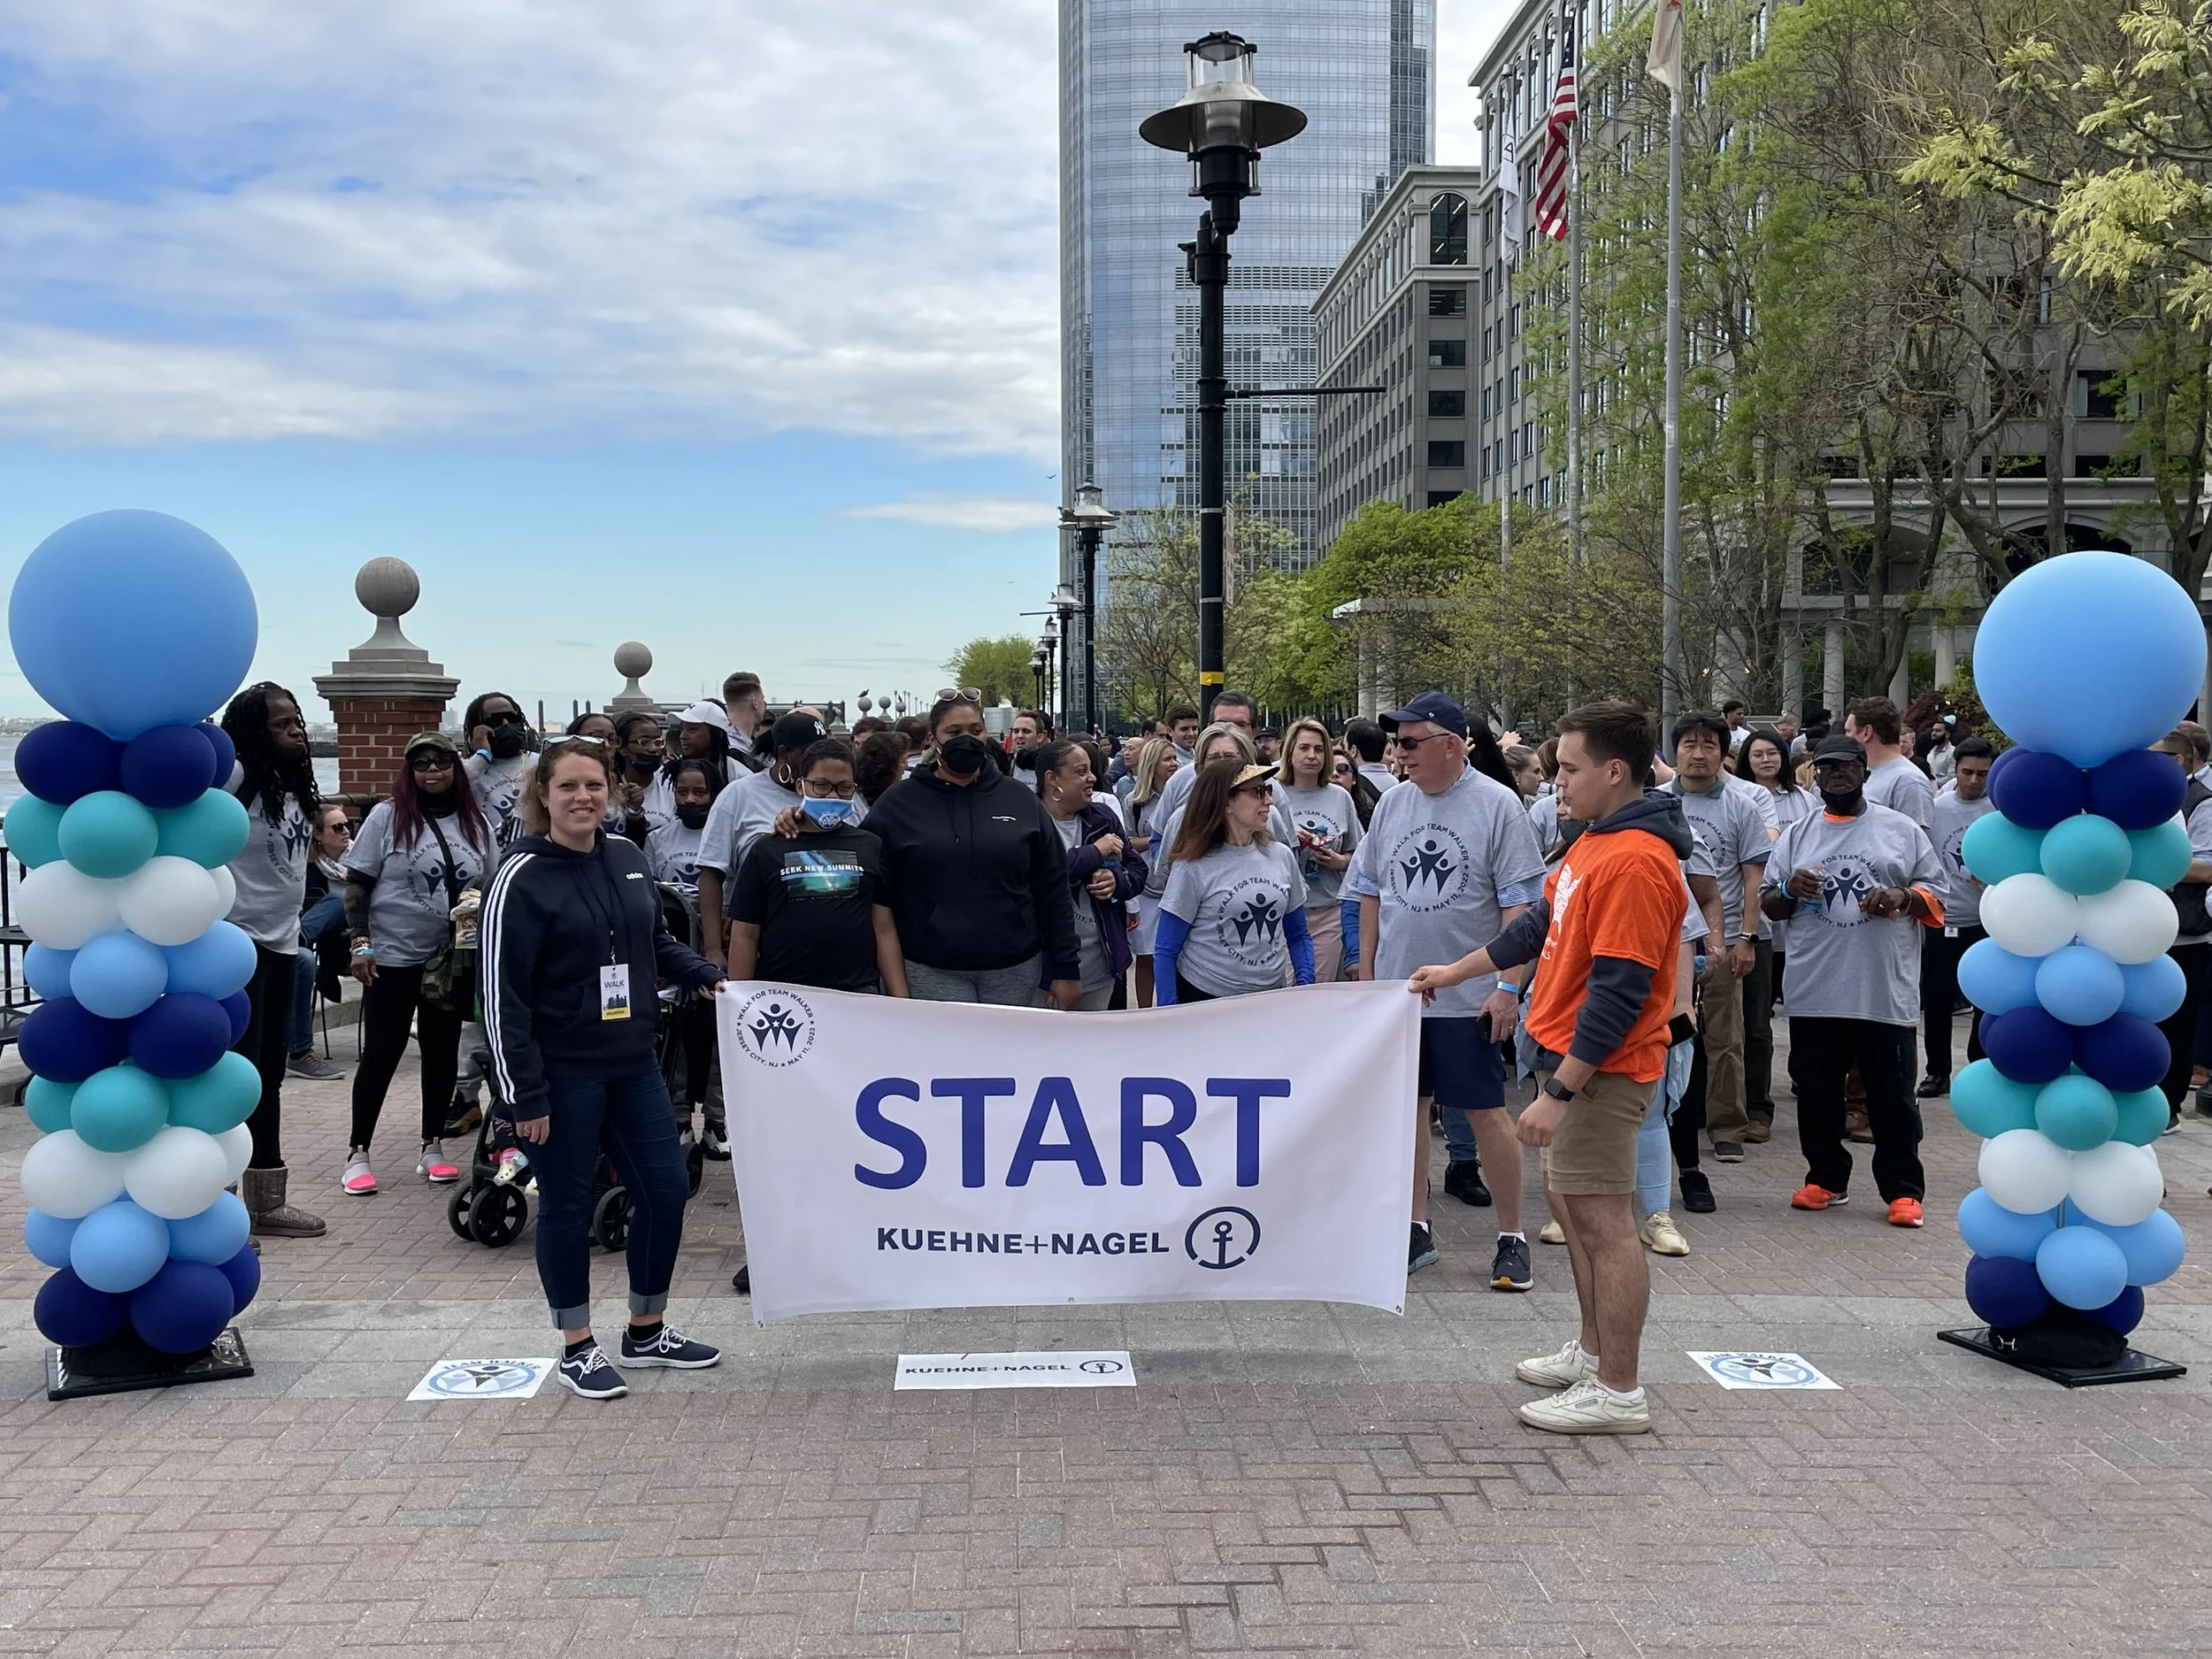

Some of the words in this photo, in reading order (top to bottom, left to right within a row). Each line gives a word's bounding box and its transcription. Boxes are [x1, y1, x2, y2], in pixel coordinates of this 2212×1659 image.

[1322, 813, 1340, 833] WALKER
[1687, 815, 1706, 824] TEAM
[1706, 820, 1725, 845] WALKER
[1392, 835, 1409, 856] WALK
[1410, 826, 1425, 837] FOR
[1426, 823, 1448, 833] TEAM
[1448, 829, 1469, 861] WALKER
[410, 848, 427, 867] WALK
[780, 866, 803, 876] SEEK
[1822, 856, 1837, 865] FOR
[1860, 856, 1881, 883] WALKER
[1217, 890, 1235, 914] WALK
[1233, 879, 1248, 892] FOR
[1432, 899, 1450, 911] MAY
[1458, 872, 1469, 893] 2022
[1858, 916, 1873, 926] MAY
[1217, 922, 1230, 948] JERSEY
[1228, 947, 1245, 964] CITY,
[604, 979, 625, 988] WALK
[737, 1001, 752, 1020] WALK
[750, 990, 766, 1002] FOR
[790, 993, 813, 1018] WALKER
[736, 1028, 751, 1053] JERSEY
[787, 1053, 803, 1065] MAY
[806, 1027, 815, 1046] 2022
[855, 1076, 1291, 1189] START
[877, 1226, 1170, 1255] KUEHNE+NAGEL
[905, 1364, 1071, 1374] KUEHNE+NAGEL
